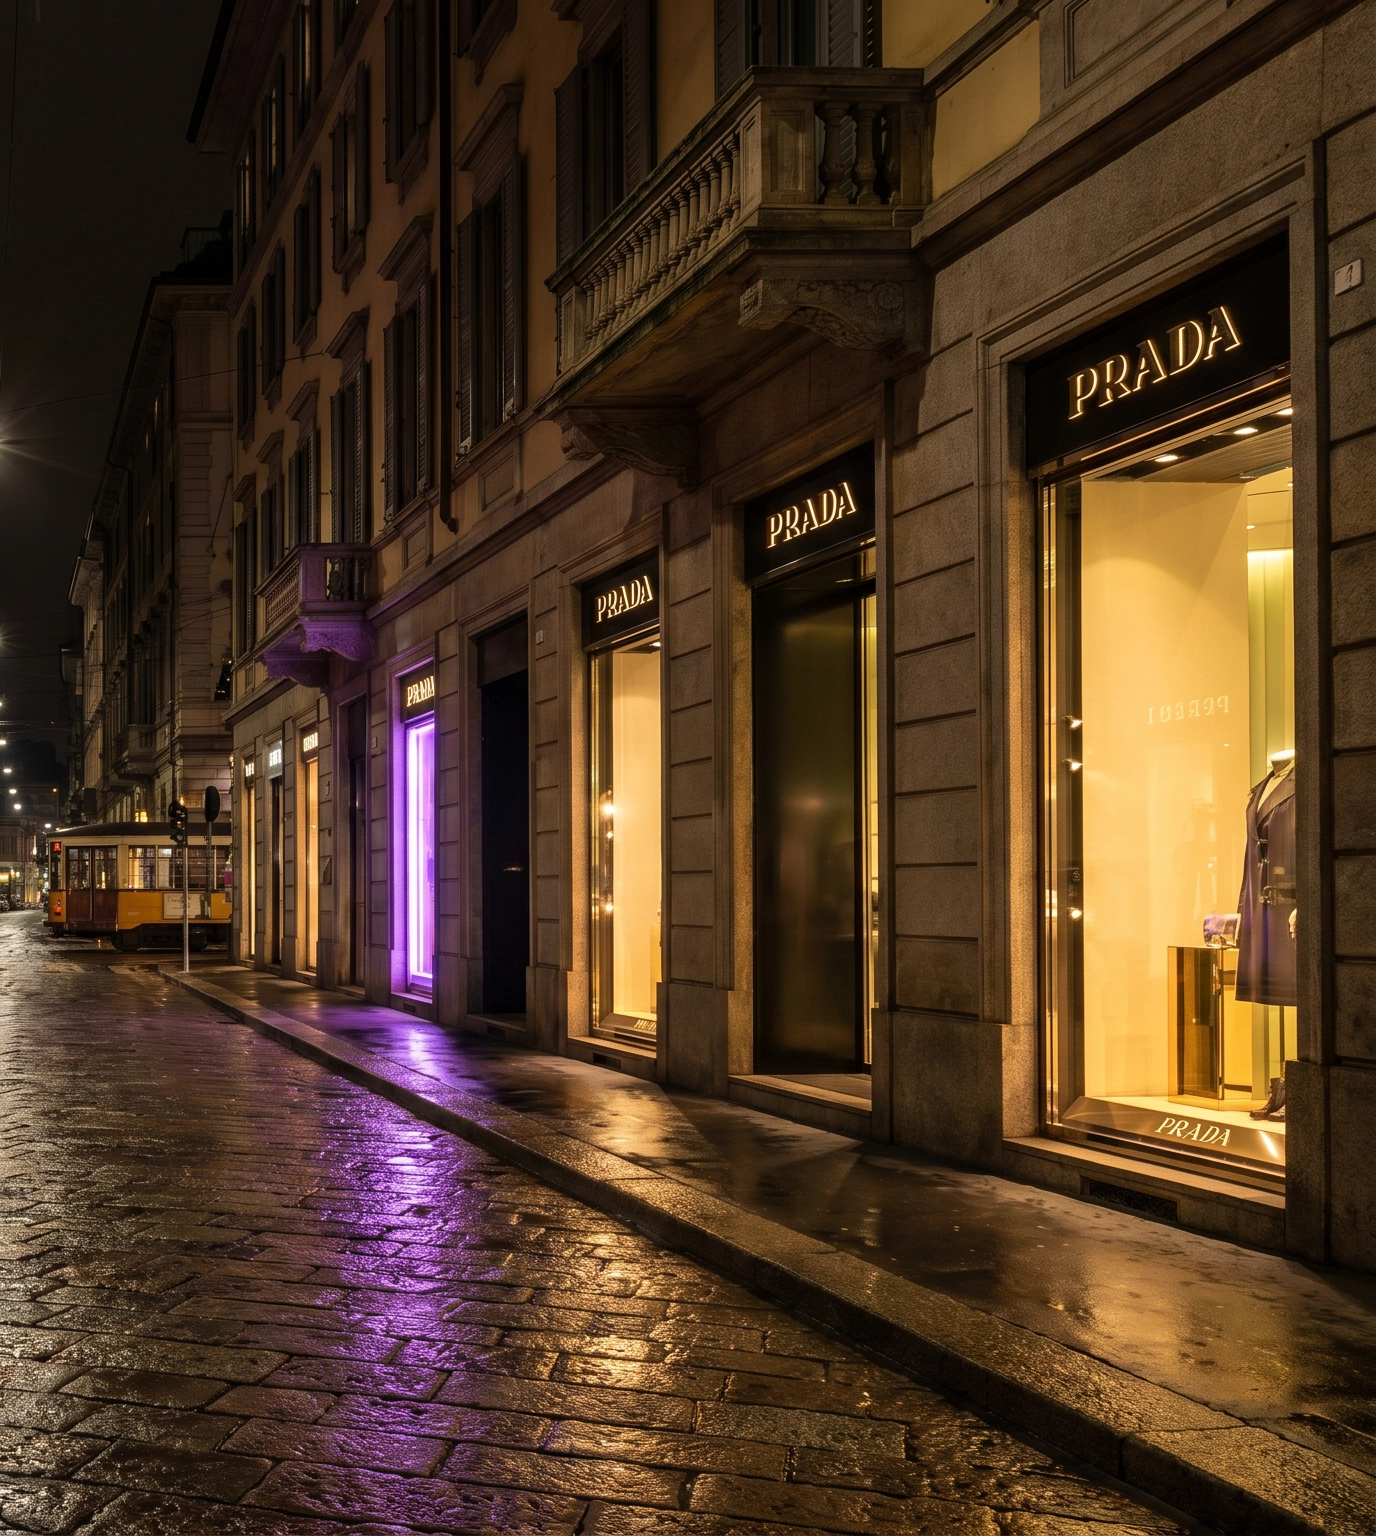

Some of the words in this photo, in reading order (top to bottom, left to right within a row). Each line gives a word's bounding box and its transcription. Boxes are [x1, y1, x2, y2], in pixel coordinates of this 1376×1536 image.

[1067, 306, 1242, 420] PRADA
[767, 481, 857, 549] PRADA
[595, 575, 654, 624] PRADA
[1154, 1117, 1231, 1147] PRADA
